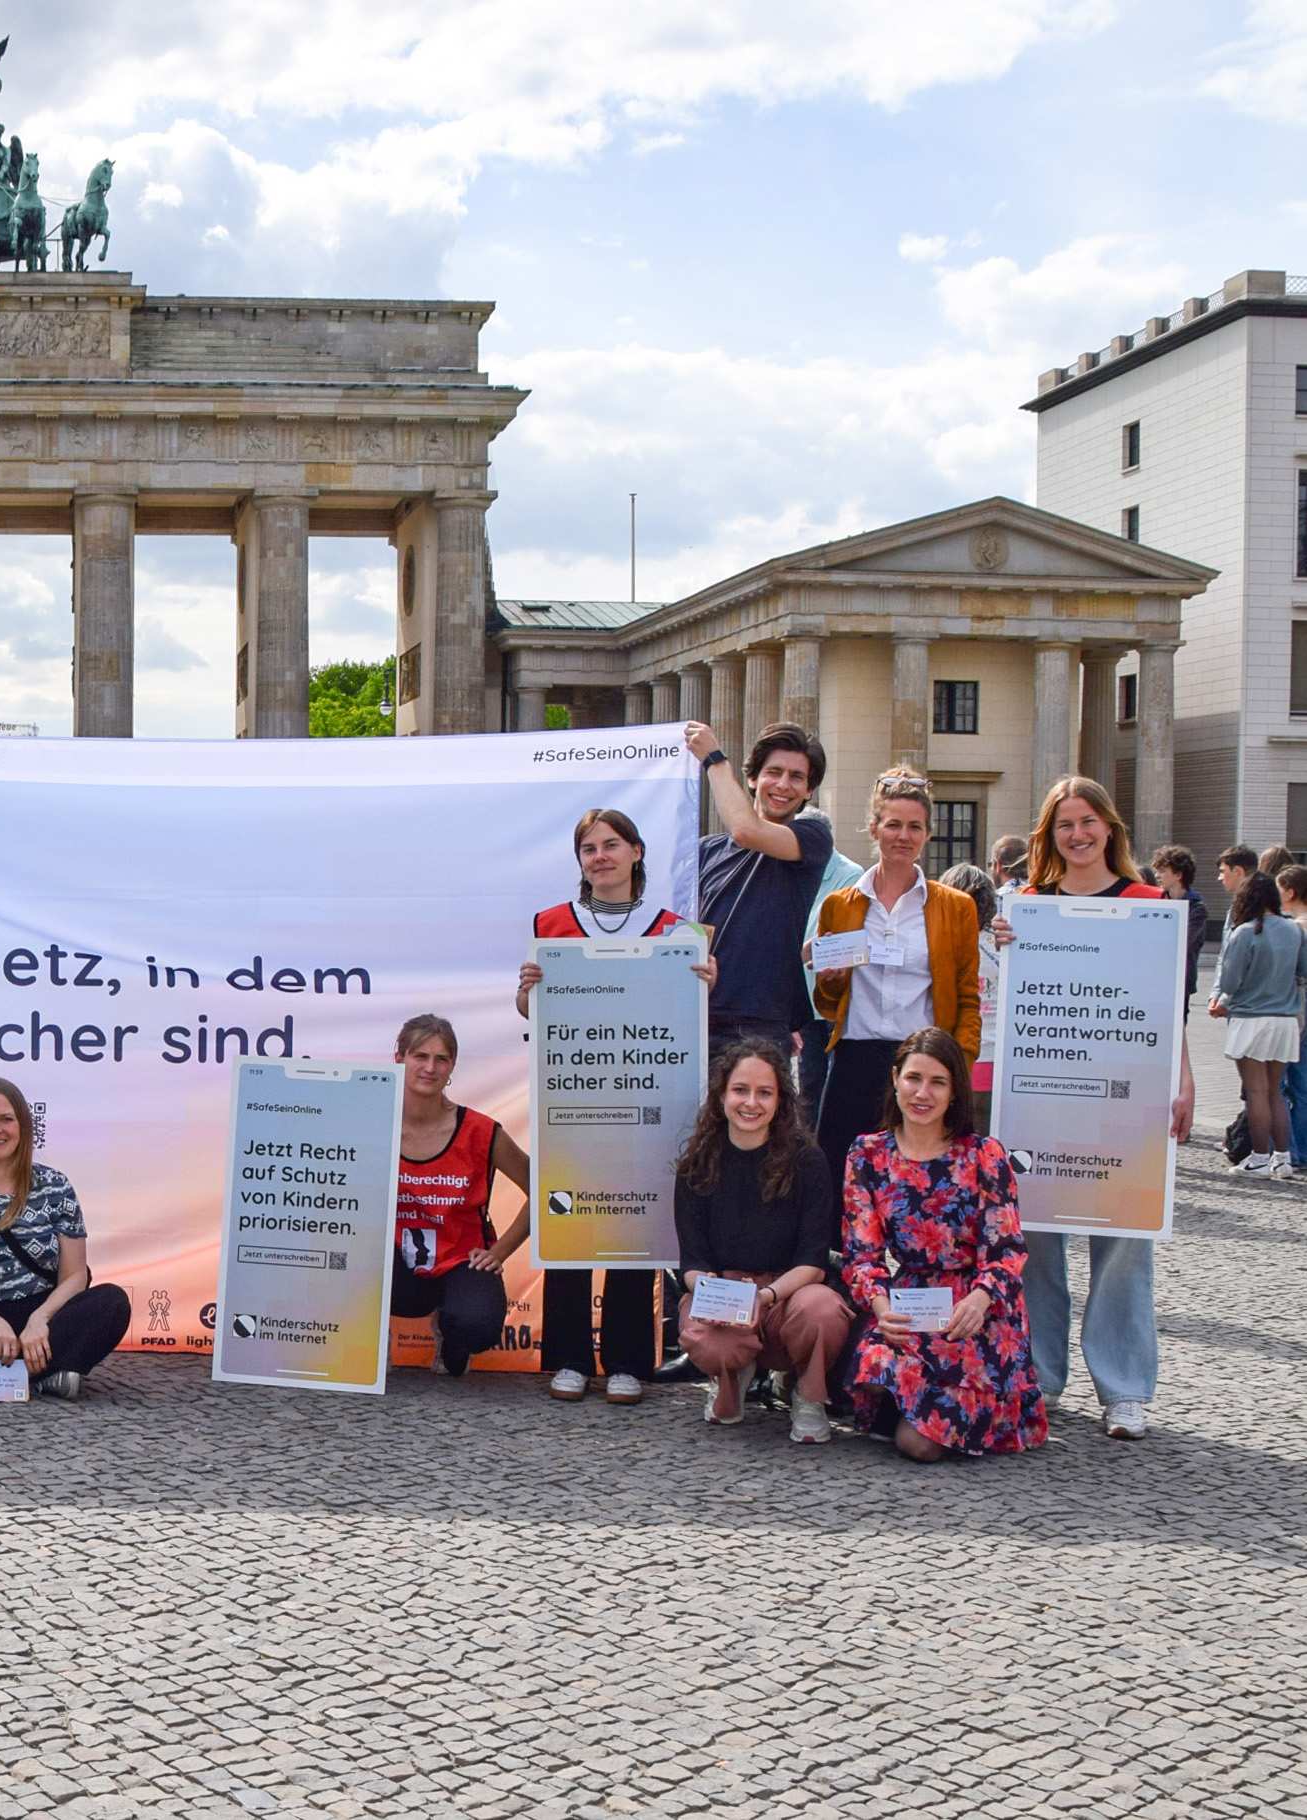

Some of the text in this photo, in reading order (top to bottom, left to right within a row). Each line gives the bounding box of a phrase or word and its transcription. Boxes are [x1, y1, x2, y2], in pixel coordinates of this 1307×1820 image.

[533, 744, 679, 763] #SafeSeinOnline
[1019, 942, 1101, 954] #SafeSeinOnline
[146, 956, 200, 988] in
[225, 955, 371, 995] dem
[546, 985, 625, 995] #SafeSeinOnline
[1016, 980, 1130, 998] Jetzt Unter-
[1015, 1002, 1146, 1021] nehmen in die
[161, 1014, 311, 1064] sind
[546, 1024, 675, 1043] Für ein Netz,
[1014, 1022, 1158, 1047] Verantwortung
[546, 1048, 689, 1065] in dem Kinder
[1013, 1044, 1093, 1062] nehmen.
[546, 1073, 659, 1090] sicher sind.
[1018, 1080, 1101, 1092] Jetzt unterschreiben
[246, 1103, 323, 1115] #SafeSeinOnline
[554, 1111, 633, 1120] Jetzt unterschreiben
[244, 1140, 357, 1161] Jetzt Recht
[1037, 1152, 1123, 1168] Kinderschutz
[242, 1164, 347, 1186] auf Schutz
[1035, 1165, 1109, 1180] im Internet
[241, 1191, 359, 1211] von Kindern
[577, 1191, 658, 1202] Kinderschutz
[576, 1204, 646, 1215] im Internet
[239, 1213, 356, 1236] priorisieren.
[244, 1250, 320, 1263] Jetzt unterschreiben
[260, 1316, 339, 1333] Kinderschutz
[141, 1337, 176, 1346] PFAD
[259, 1330, 327, 1345] im Internet
